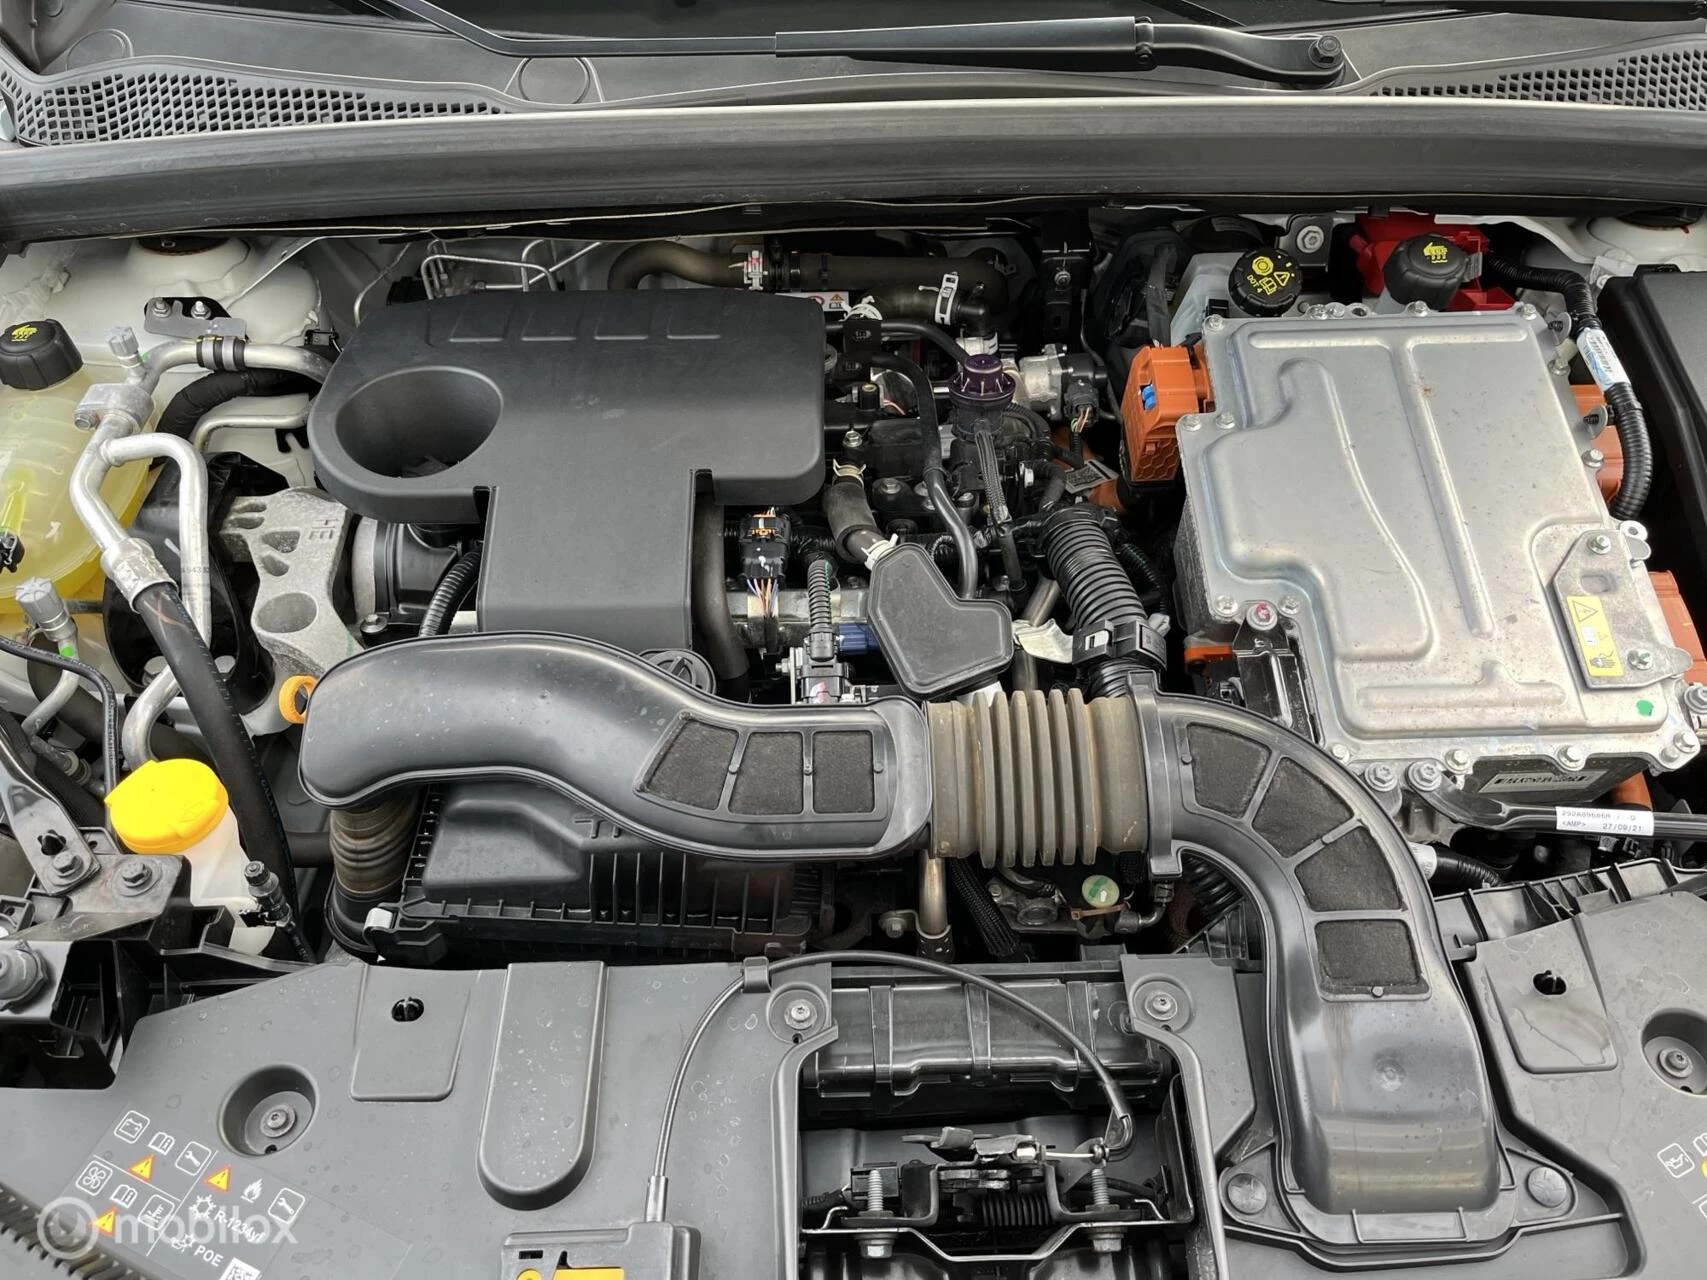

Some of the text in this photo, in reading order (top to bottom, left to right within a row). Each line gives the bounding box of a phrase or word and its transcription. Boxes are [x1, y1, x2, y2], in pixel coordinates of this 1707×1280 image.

[1246, 274, 1259, 287] DOT
[1602, 823, 1642, 832] 27/09/21
[214, 1208, 266, 1242] R-1234yf
[193, 1244, 224, 1267] POE
